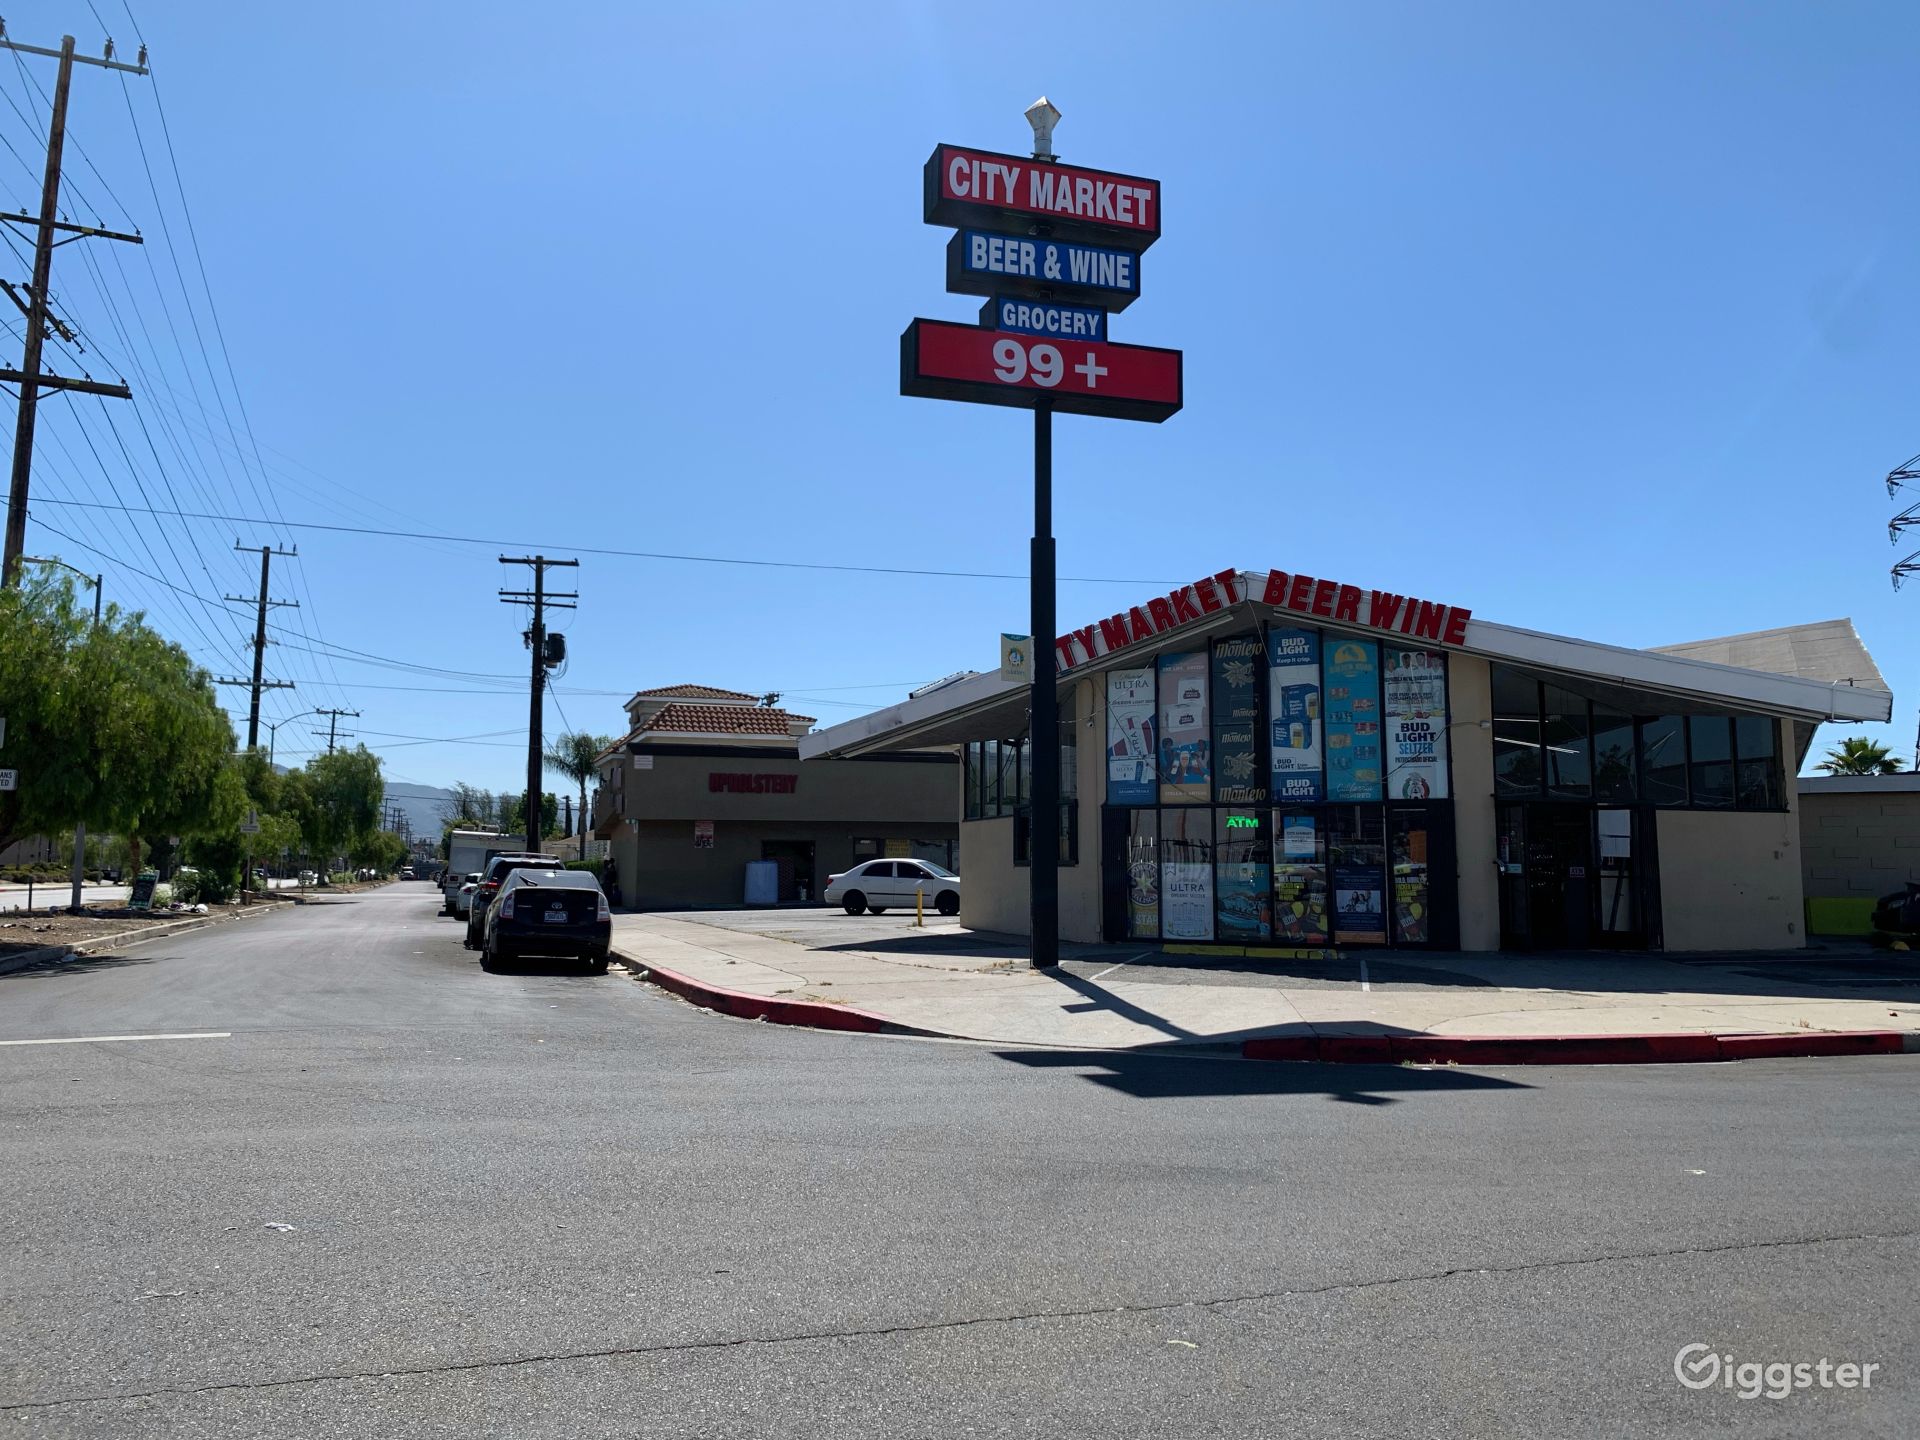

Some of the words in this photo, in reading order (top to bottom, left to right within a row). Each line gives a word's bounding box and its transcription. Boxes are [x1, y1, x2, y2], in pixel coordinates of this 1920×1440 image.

[949, 156, 1021, 204] CITY
[1029, 170, 1151, 226] MARKET
[971, 235, 1036, 277] BEER
[1043, 245, 1062, 280] &
[1069, 248, 1131, 289] WINE
[1002, 303, 1100, 336] GROCERY
[992, 339, 1064, 387] 99
[1262, 569, 1361, 623] BEER
[1369, 589, 1472, 646] WINE
[1056, 624, 1097, 672] TY
[1098, 568, 1240, 653] MARKET
[1281, 637, 1305, 647] BUD
[1277, 645, 1310, 655] LIGHT
[1114, 680, 1149, 690] ULTRA
[1400, 722, 1430, 732] BUD
[1395, 732, 1436, 742] LIGHT
[1399, 743, 1434, 754] SELTZER
[709, 772, 798, 793] UPHOLSTERY
[1286, 779, 1310, 787] BUD
[1282, 787, 1314, 796] LIGHT
[1226, 816, 1259, 828] ATM
[1170, 883, 1205, 892] ULTRA
